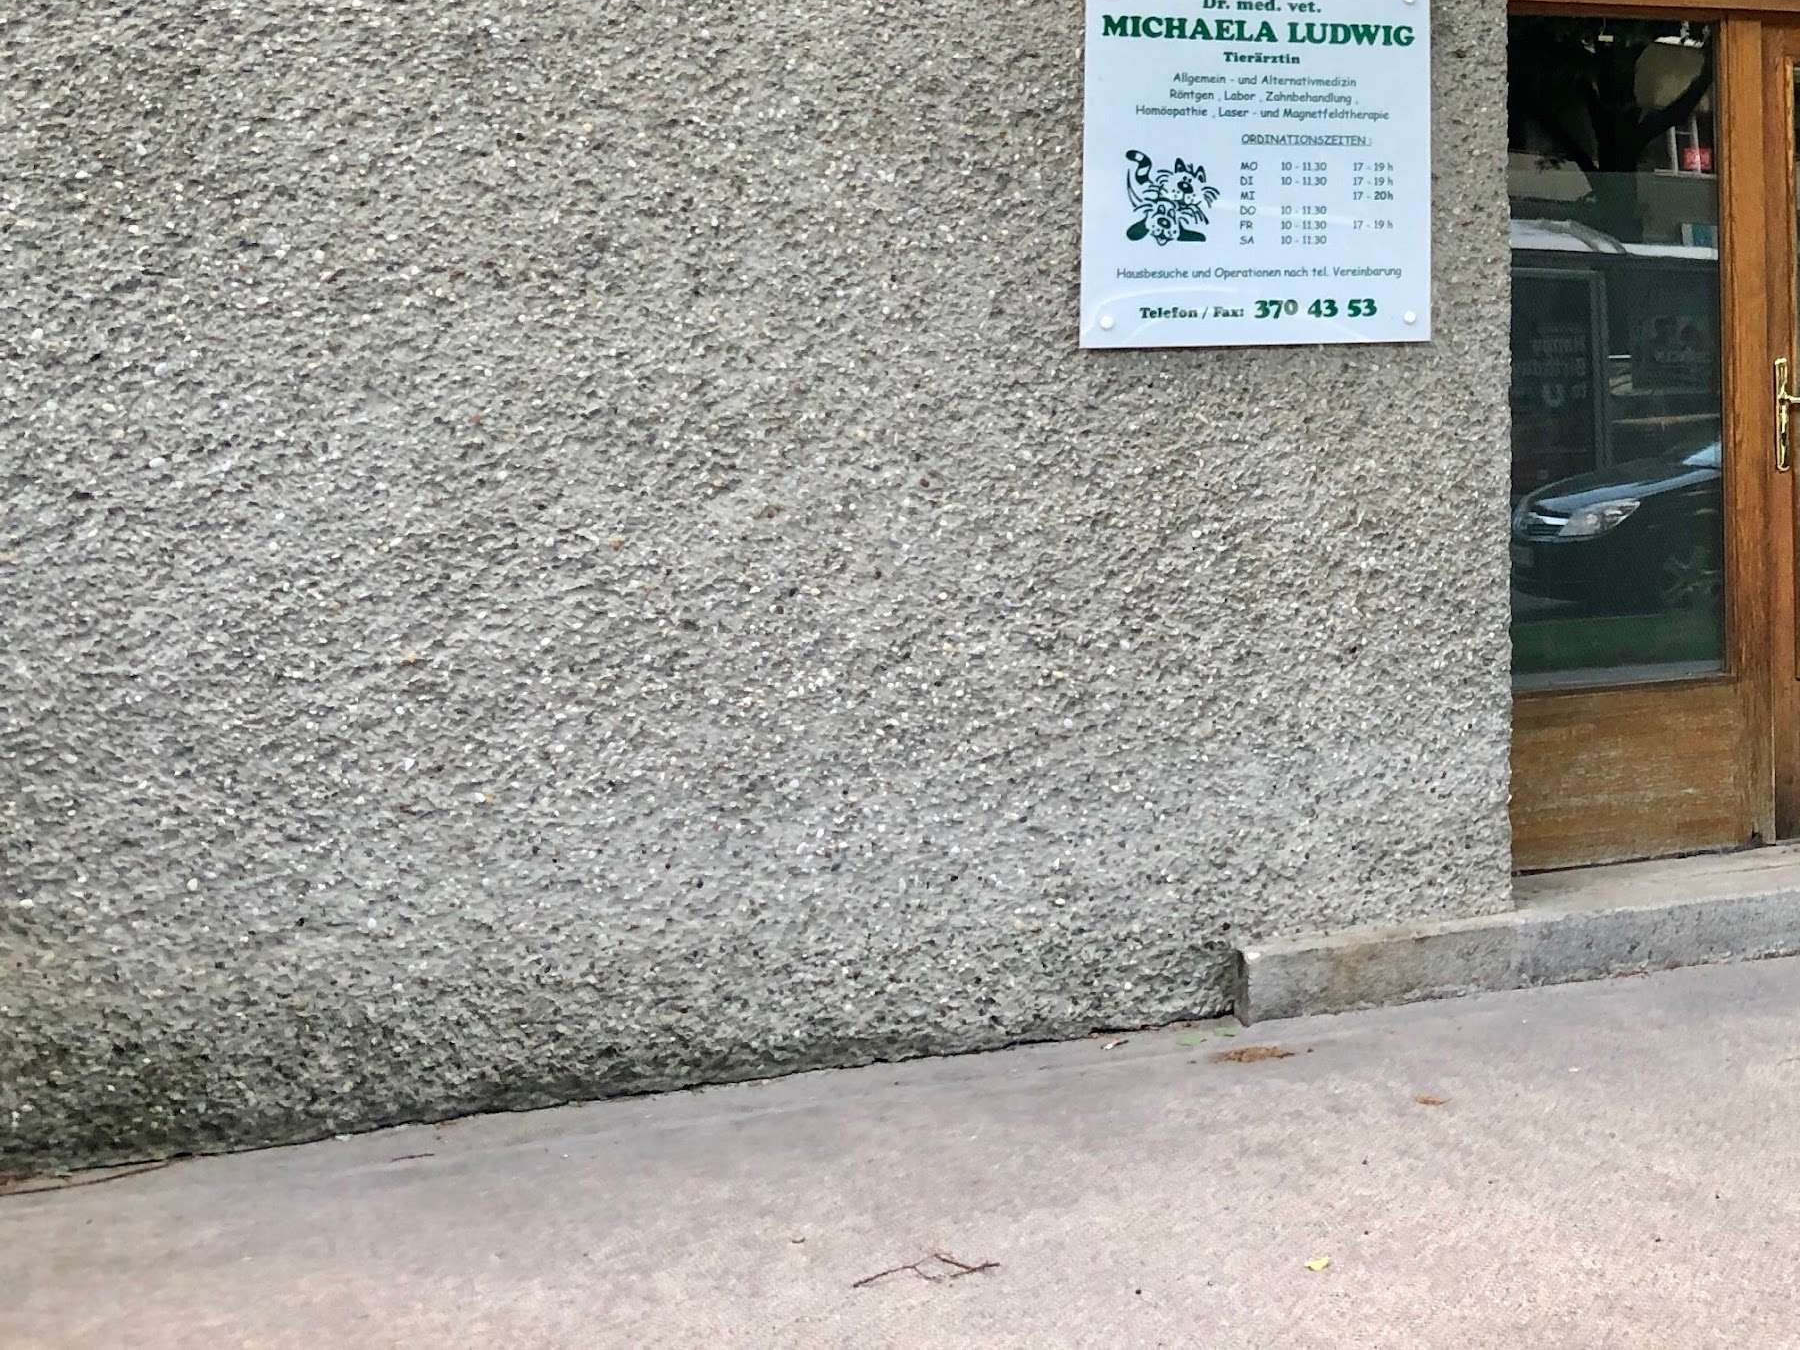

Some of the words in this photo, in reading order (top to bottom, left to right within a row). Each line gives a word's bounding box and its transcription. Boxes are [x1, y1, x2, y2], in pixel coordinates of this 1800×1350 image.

[1236, 0, 1281, 12] med.
[1287, 1, 1322, 13] vet.
[1101, 14, 1279, 43] MICHAELA
[1287, 21, 1415, 47] LUDWIG
[1223, 51, 1301, 64] Tierärztin
[1172, 72, 1227, 86] Allgemein
[1238, 75, 1258, 85] und
[1260, 75, 1357, 87] Alternativmedizin
[1135, 105, 1208, 118] Homöopathie
[1218, 106, 1249, 117] Laser
[1260, 108, 1280, 118] und
[1282, 108, 1390, 122] Magnetfeldtherapie
[1240, 162, 1258, 171] MO
[1281, 162, 1292, 171] 10
[1353, 162, 1364, 171] 17
[1240, 176, 1255, 186] DI
[1281, 176, 1292, 186] 10
[1353, 176, 1364, 186] 17
[1240, 191, 1256, 200] MI
[1353, 191, 1364, 200] 17
[1240, 206, 1257, 215] DO
[1281, 206, 1292, 215] 10
[1240, 220, 1254, 230] FR
[1281, 220, 1292, 230] 10
[1353, 220, 1364, 230] 17
[1240, 235, 1255, 245] SA
[1281, 235, 1292, 245] 10
[1116, 268, 1189, 279] Hausbesuche
[1191, 267, 1211, 278] und
[1214, 267, 1281, 280] Operationen
[1283, 267, 1308, 277] nach
[1332, 266, 1402, 278] Vereinbarung
[1139, 307, 1198, 319] Telefon
[1212, 306, 1245, 318] Fax:
[1253, 298, 1298, 319] 370
[1307, 298, 1339, 318] 43
[1347, 298, 1378, 317] 53
